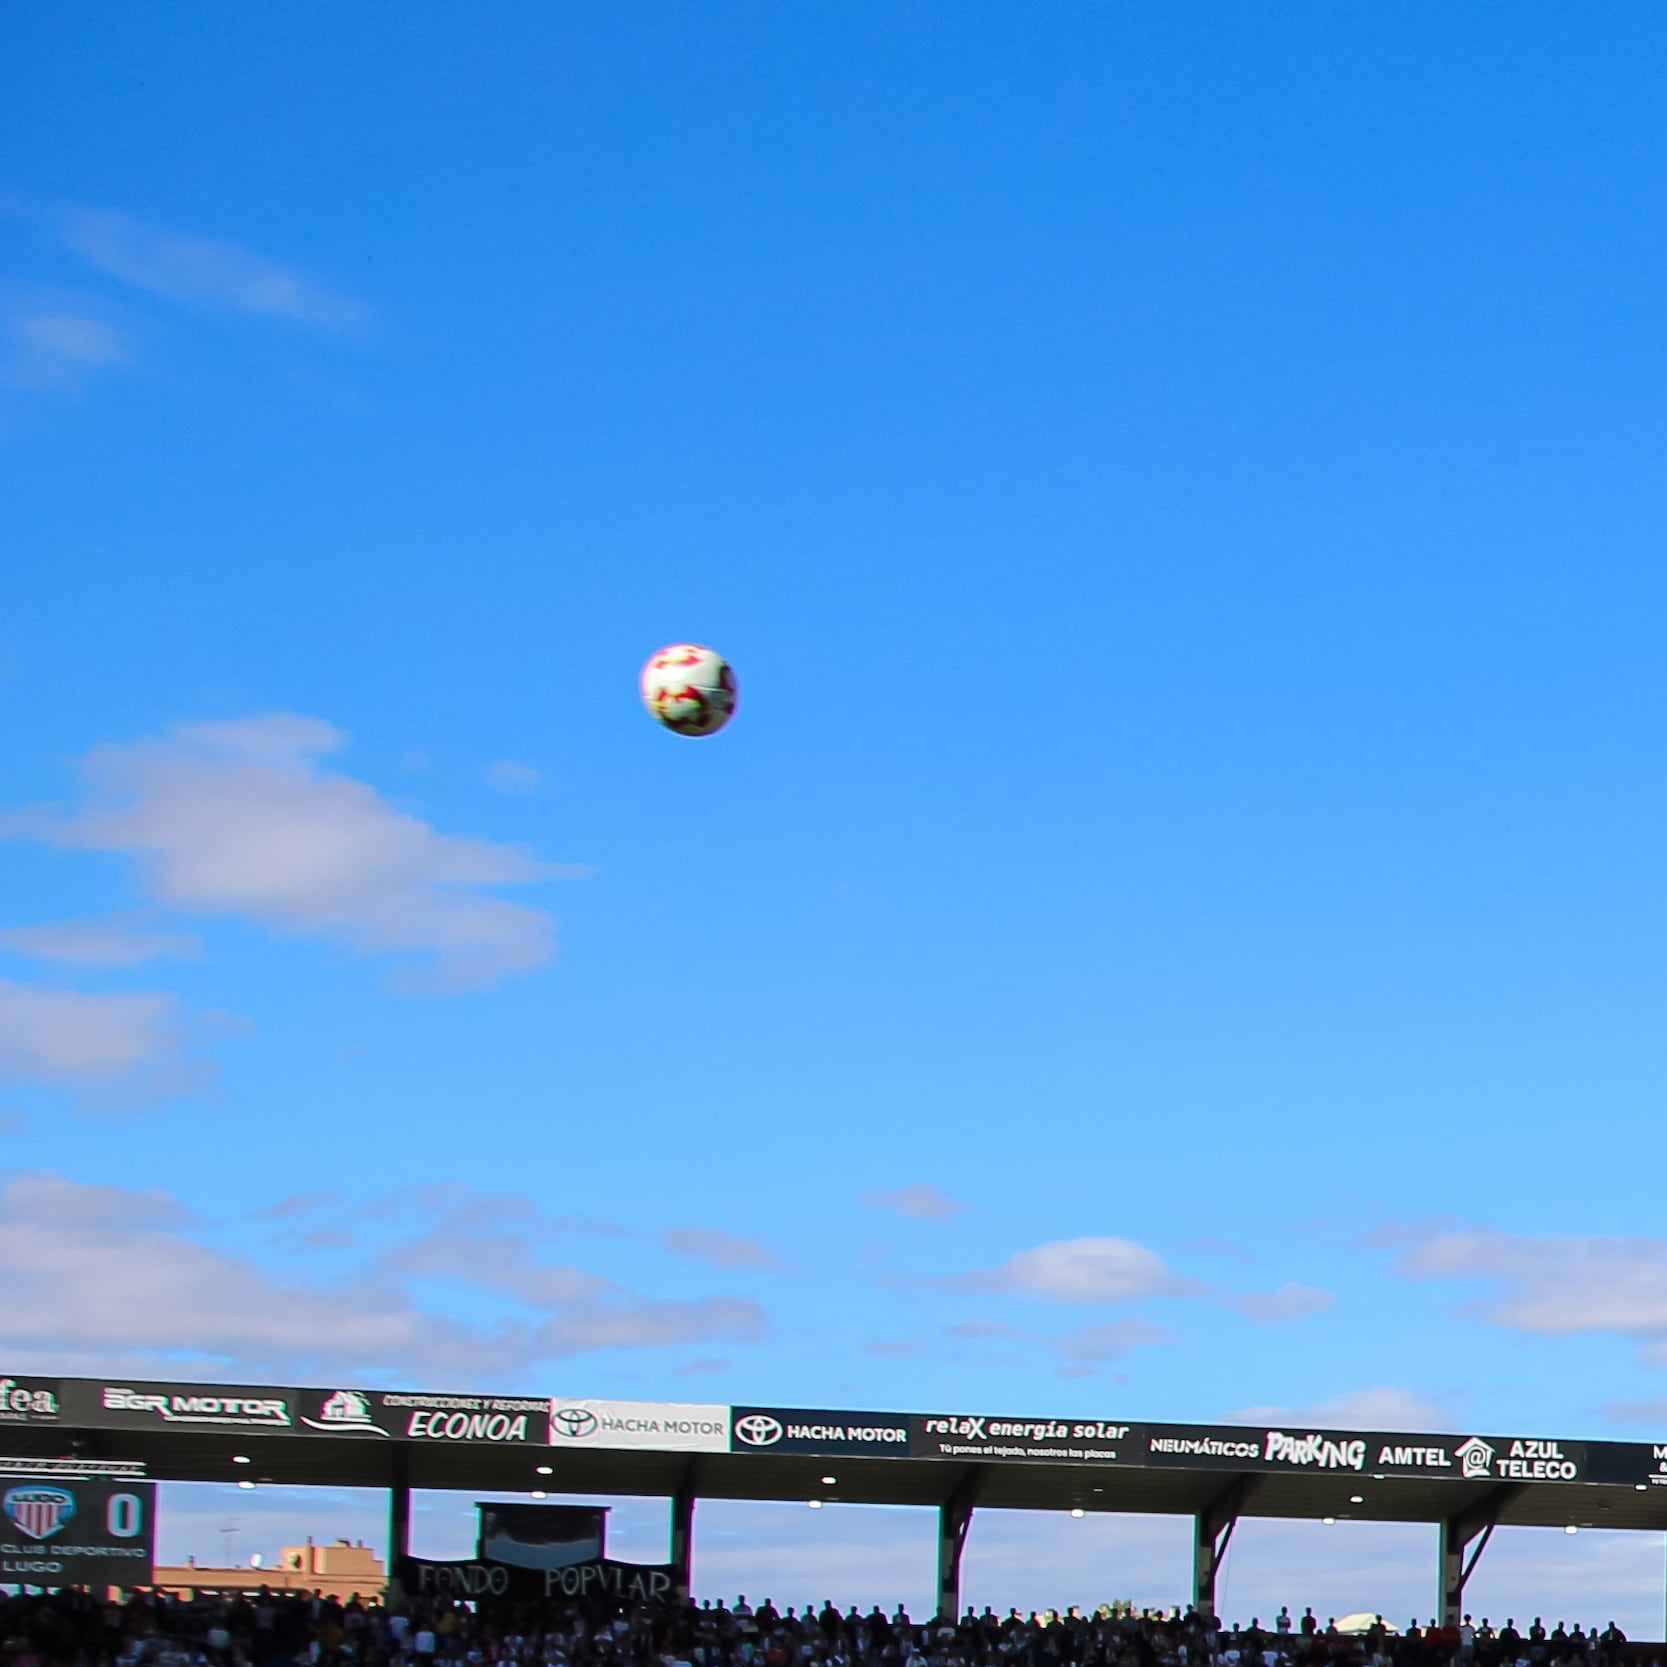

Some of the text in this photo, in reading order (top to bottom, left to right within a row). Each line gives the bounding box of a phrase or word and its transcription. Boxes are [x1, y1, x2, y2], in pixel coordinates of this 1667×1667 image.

[172, 1397, 292, 1422] MOTOR
[408, 1411, 529, 1442] ECONOA
[602, 1416, 725, 1436] HACHA MOTOR
[787, 1424, 908, 1444] HACHA MOTOR
[989, 1420, 1069, 1441] energía
[1072, 1422, 1130, 1440] solar
[1150, 1431, 1452, 1471] NEUMÁTICOS PARKING AMTEL
[1510, 1441, 1564, 1460] AZUL
[1497, 1459, 1577, 1480] TELECO
[1660, 1462, 1667, 1473] &
[107, 1493, 143, 1538] 0
[0, 1544, 147, 1558] CLUB DEPORTIVO
[2, 1561, 64, 1573] LUGO
[416, 1564, 508, 1595] FONDO
